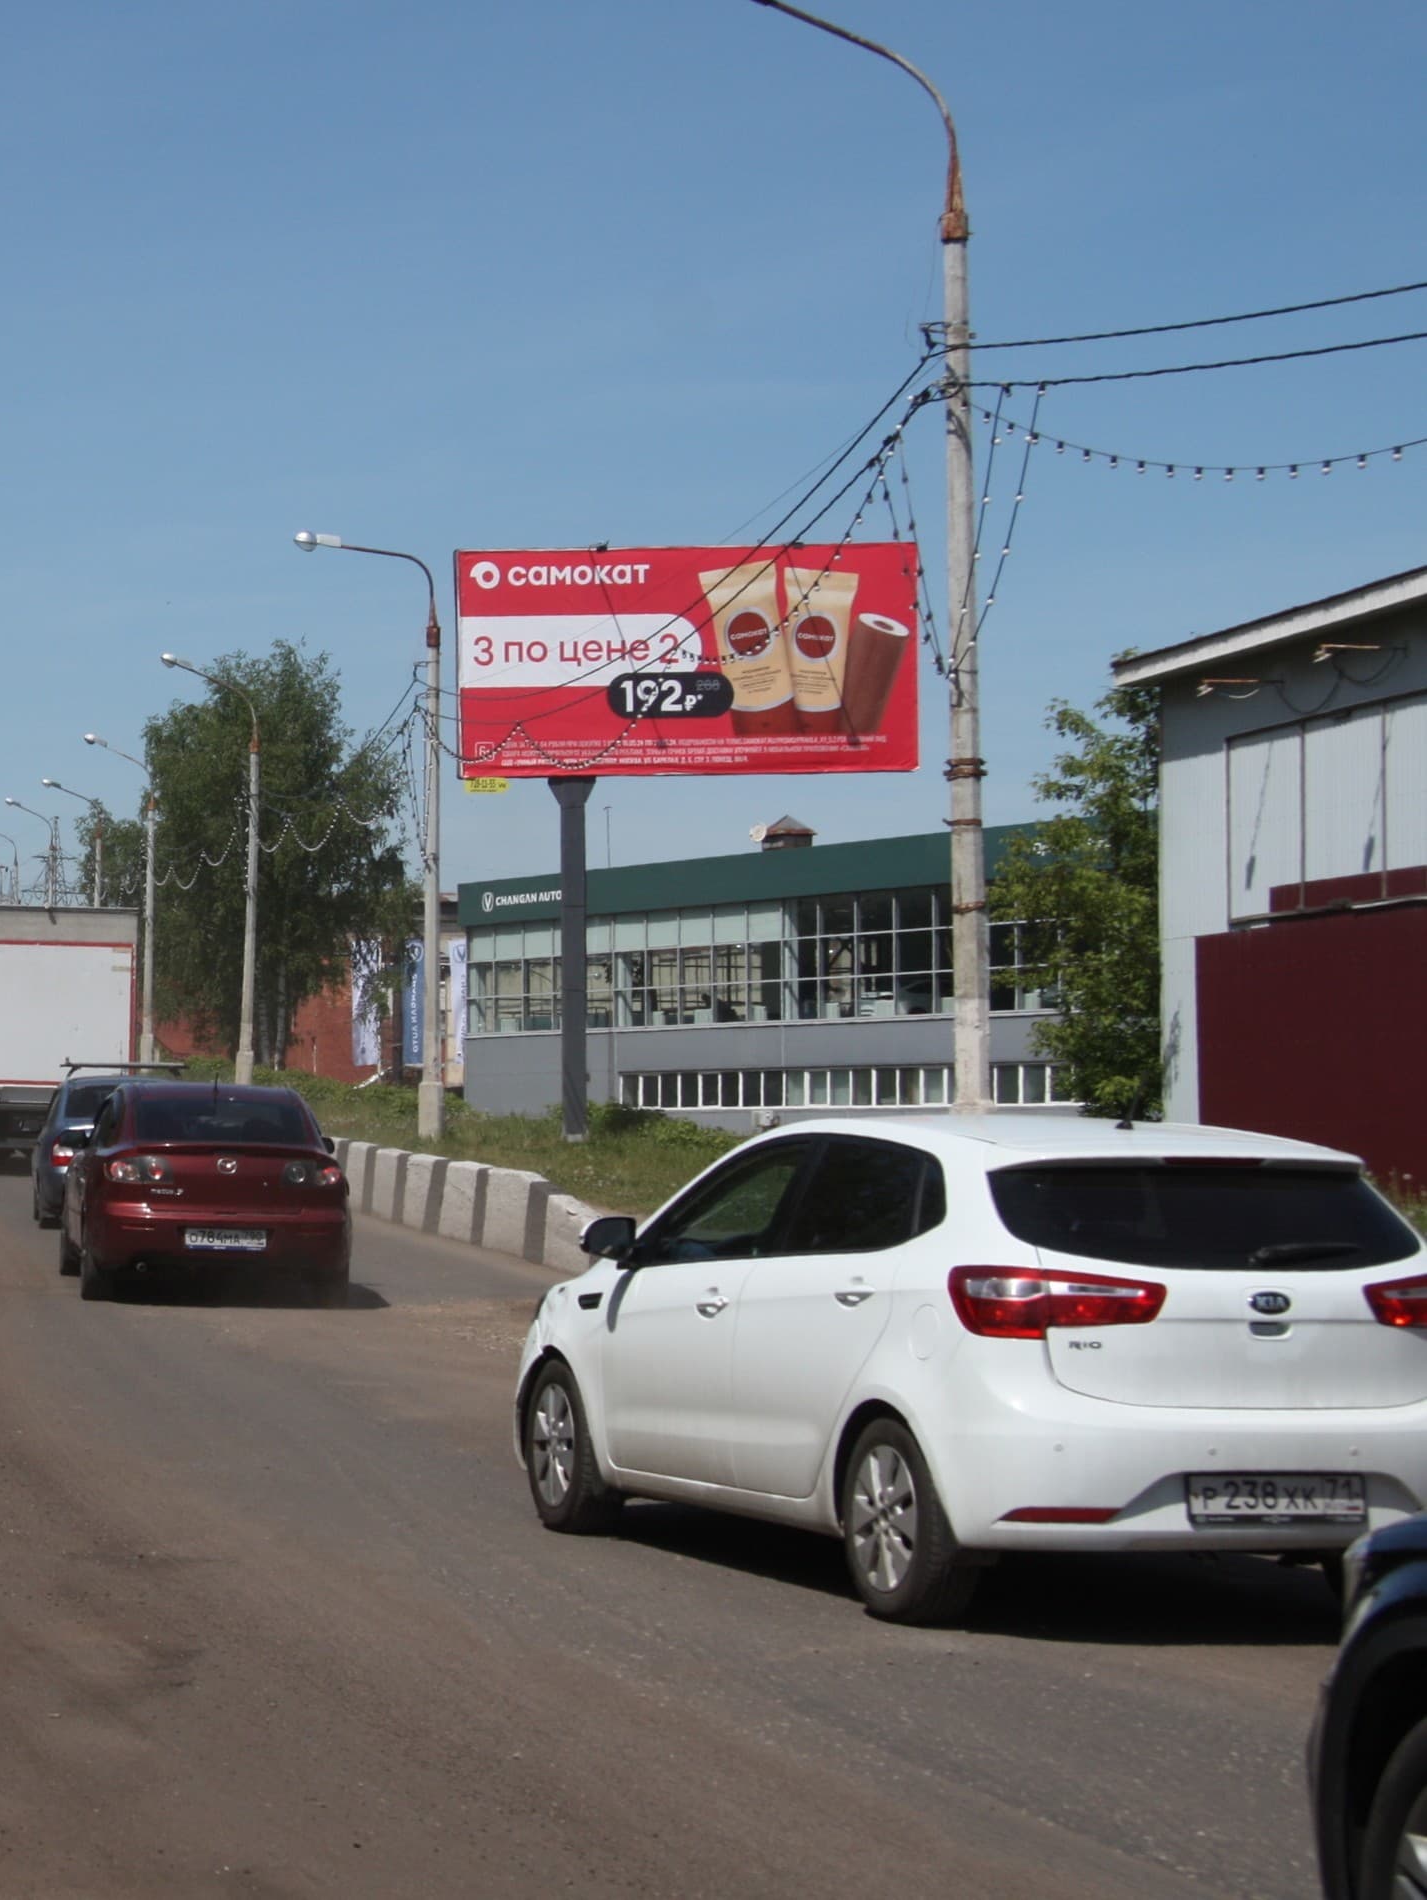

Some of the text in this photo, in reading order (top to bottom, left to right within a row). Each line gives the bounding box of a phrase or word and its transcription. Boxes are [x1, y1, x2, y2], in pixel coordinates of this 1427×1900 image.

[507, 564, 651, 587] самокат
[473, 633, 679, 667] 3 по цене 2
[495, 890, 562, 907] CHANGAN AUTO
